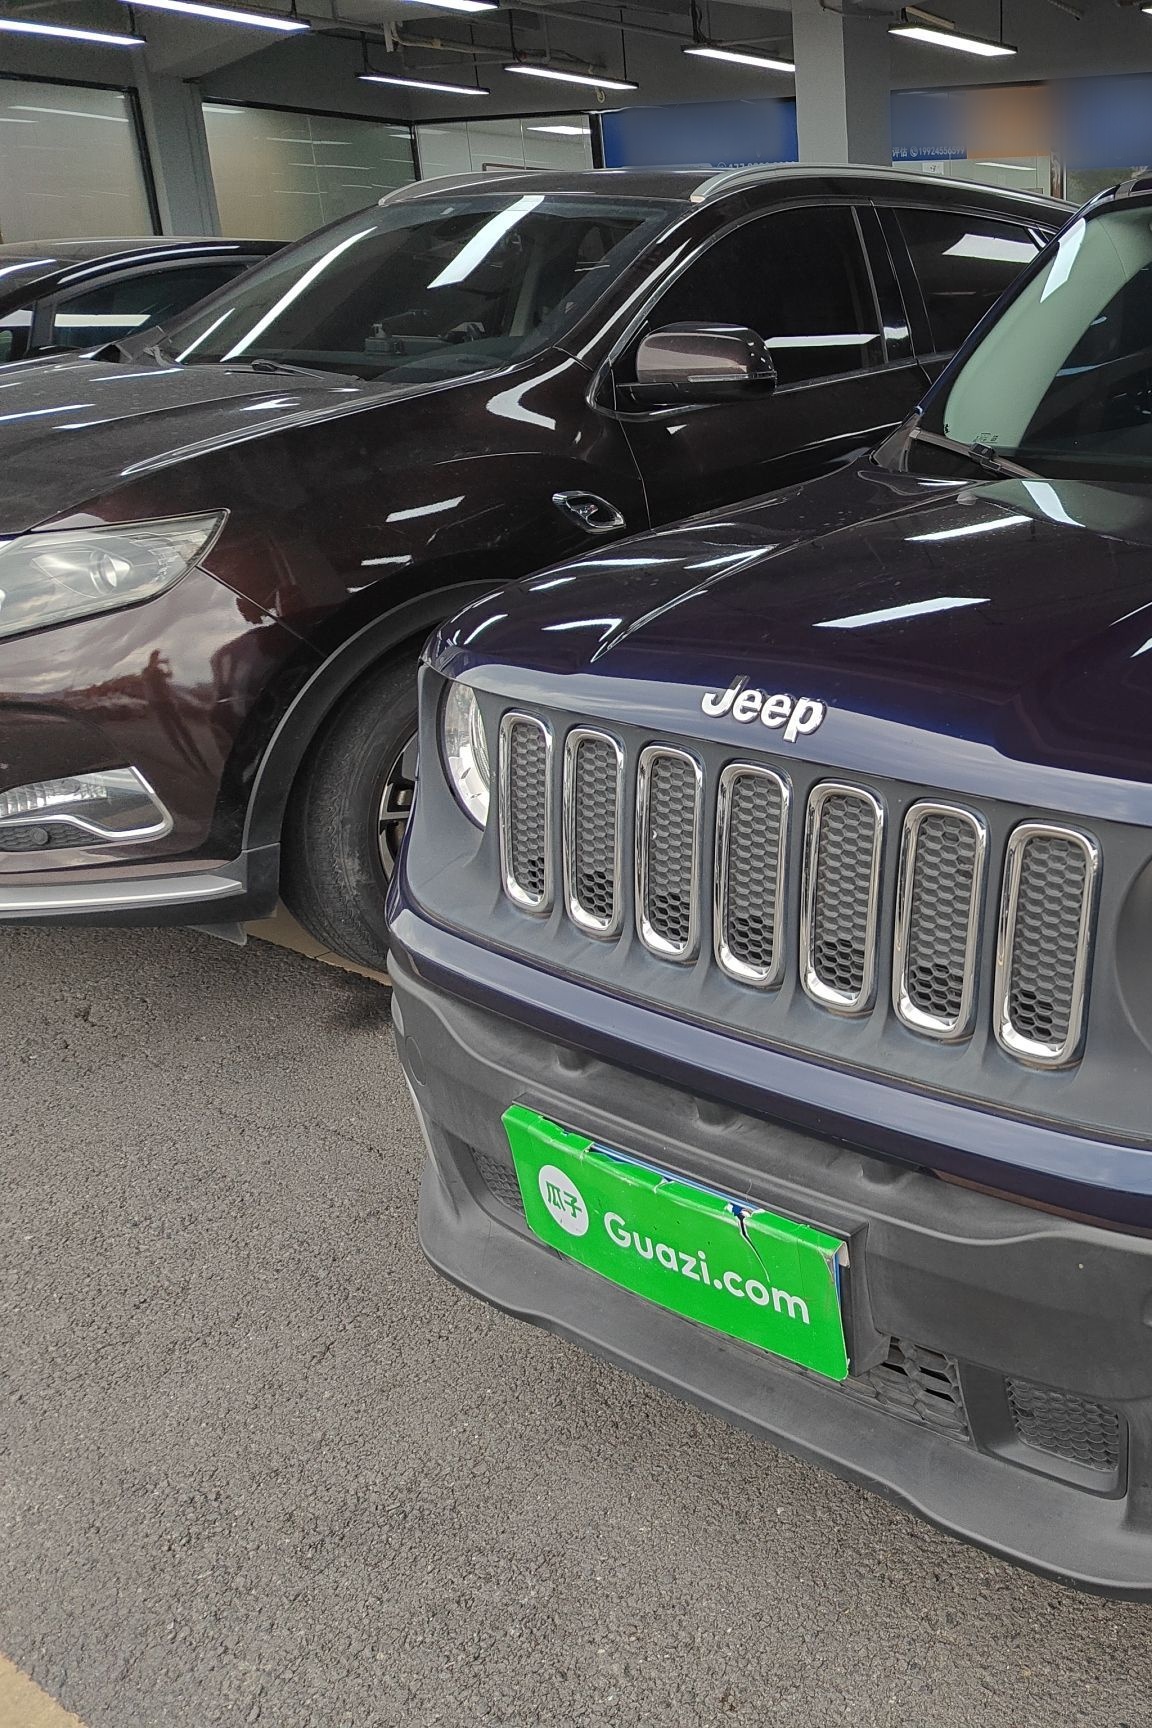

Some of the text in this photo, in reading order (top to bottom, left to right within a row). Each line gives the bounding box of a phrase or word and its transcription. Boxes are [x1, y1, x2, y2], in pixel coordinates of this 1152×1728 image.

[892, 146, 908, 158] 评估
[701, 675, 828, 743] Jeep
[545, 1181, 582, 1219] 瓜子
[604, 1211, 810, 1325] Guazi.com
